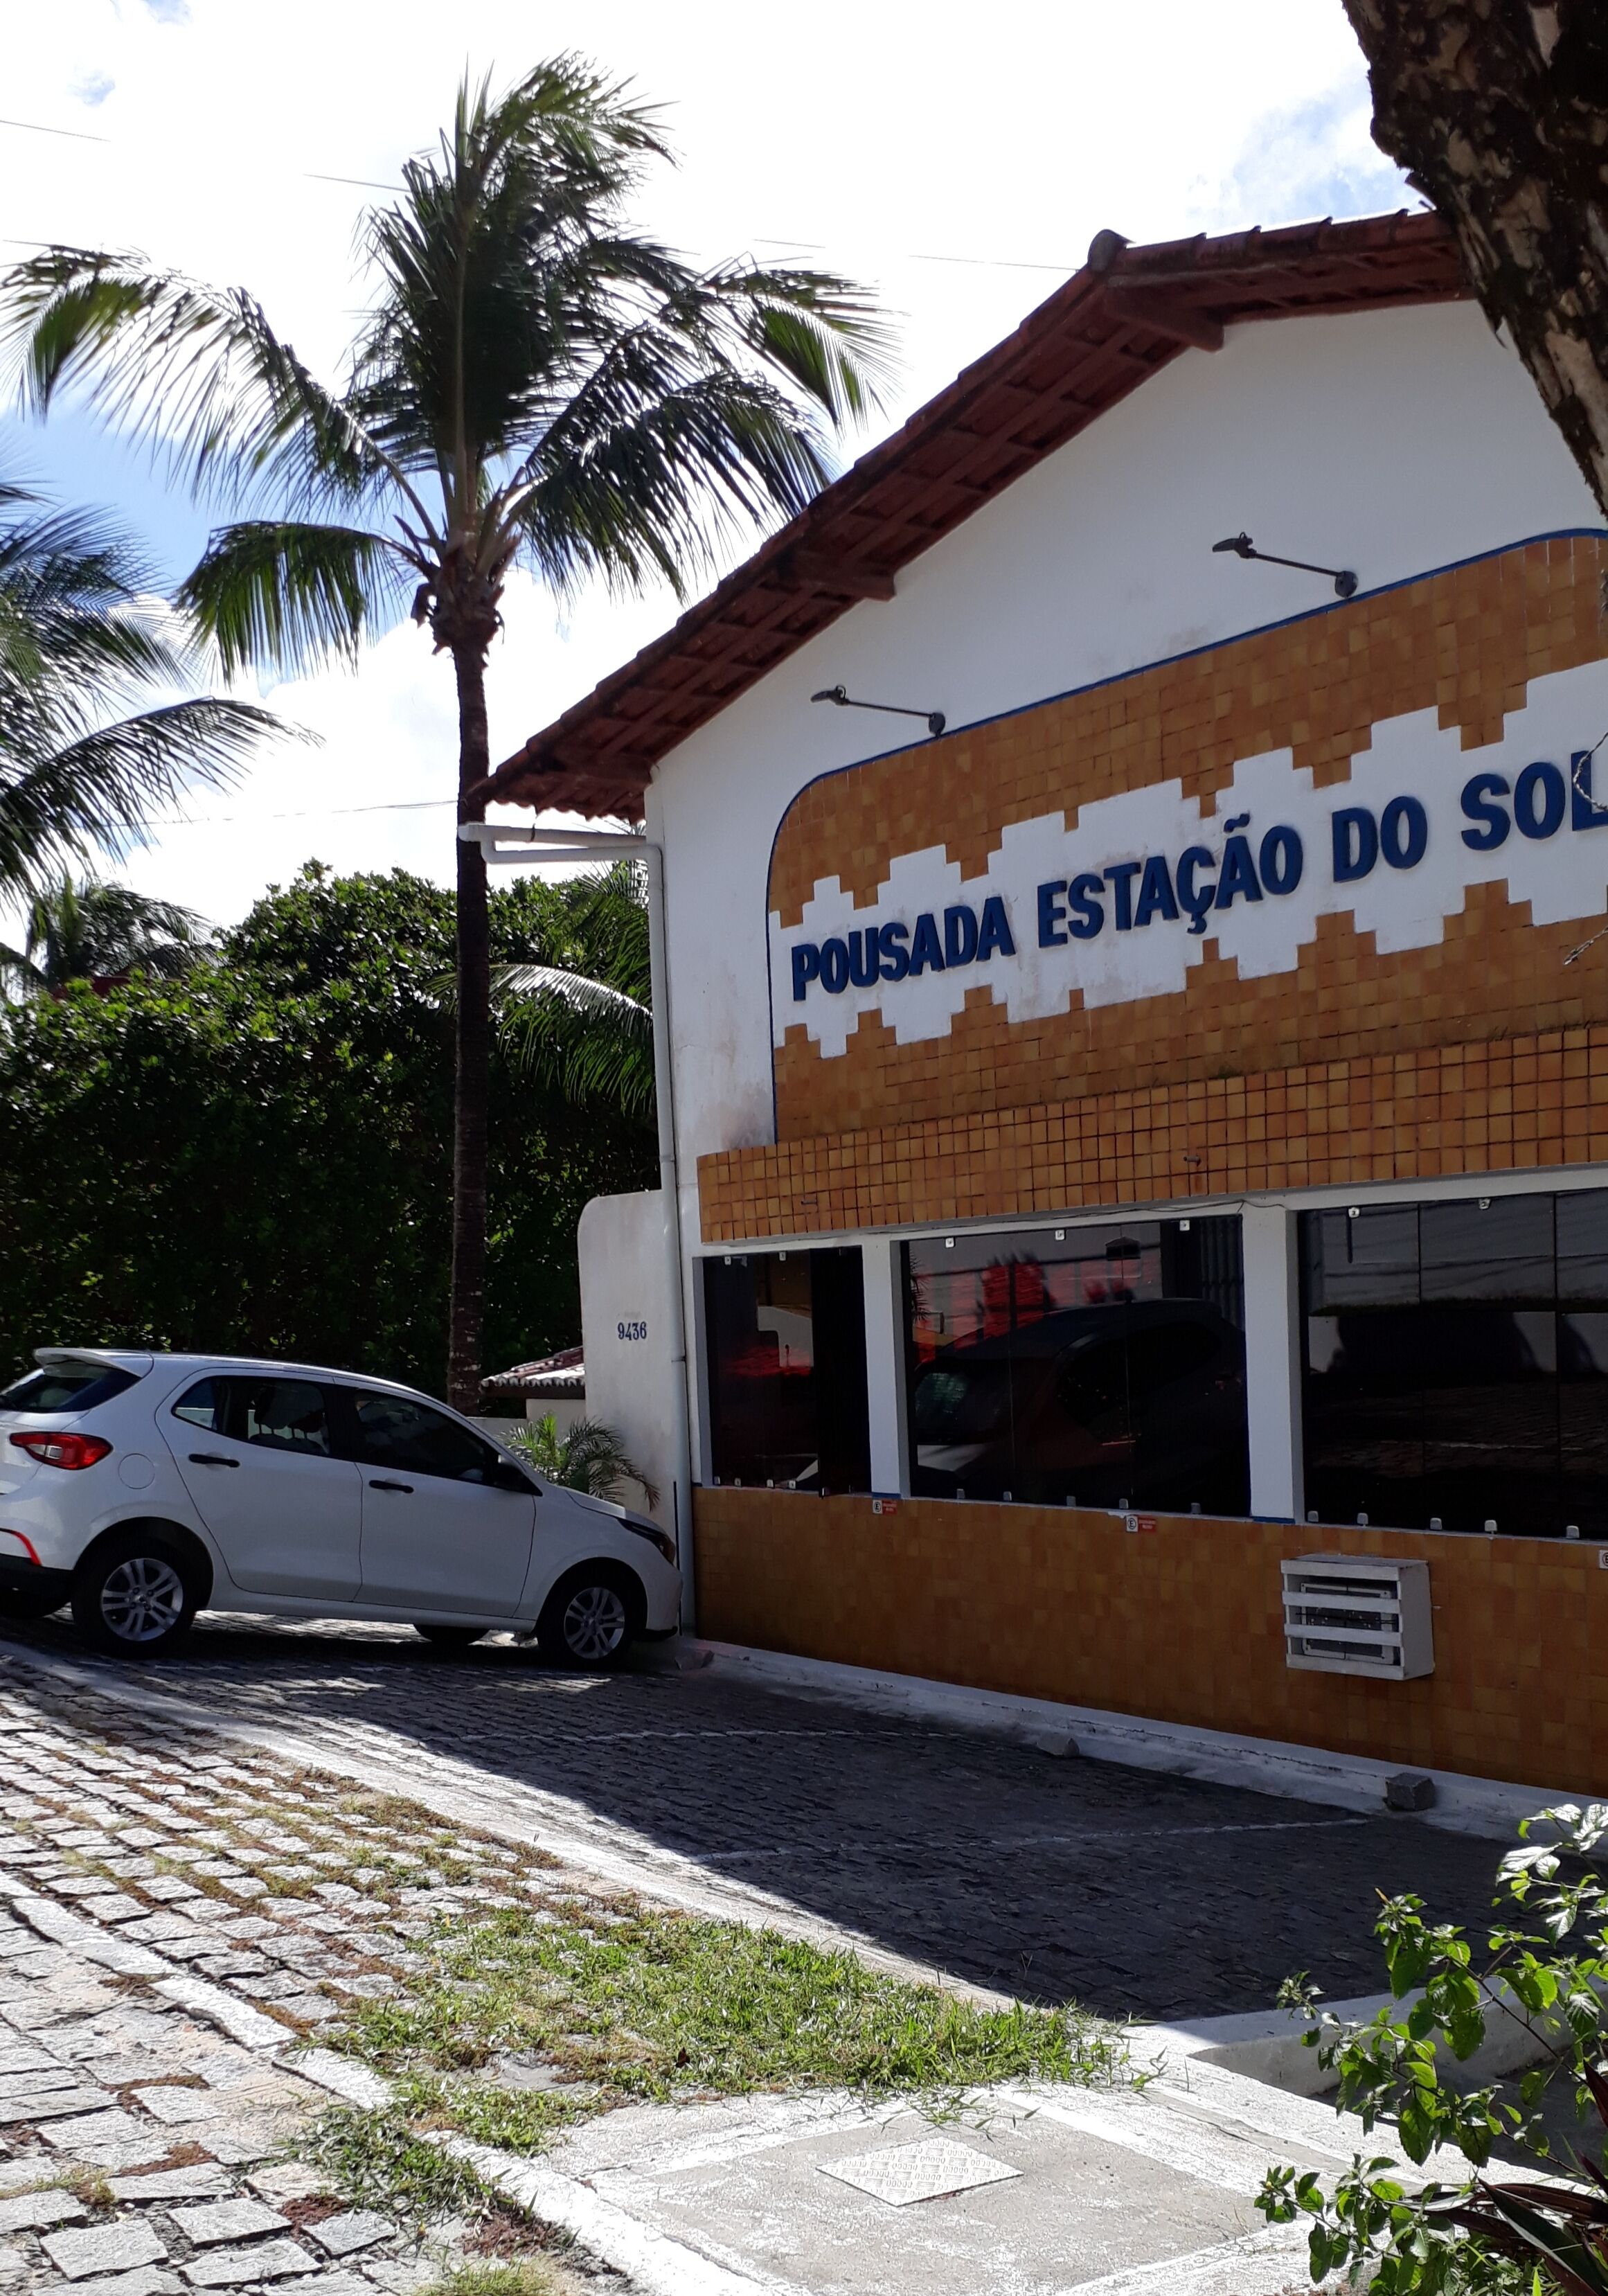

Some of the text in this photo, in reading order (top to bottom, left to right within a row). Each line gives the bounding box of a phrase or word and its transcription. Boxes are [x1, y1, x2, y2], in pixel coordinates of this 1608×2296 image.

[791, 749, 1608, 1002] POUSADA ESTAÇÃO DO SOL
[618, 1321, 647, 1341] 9436
